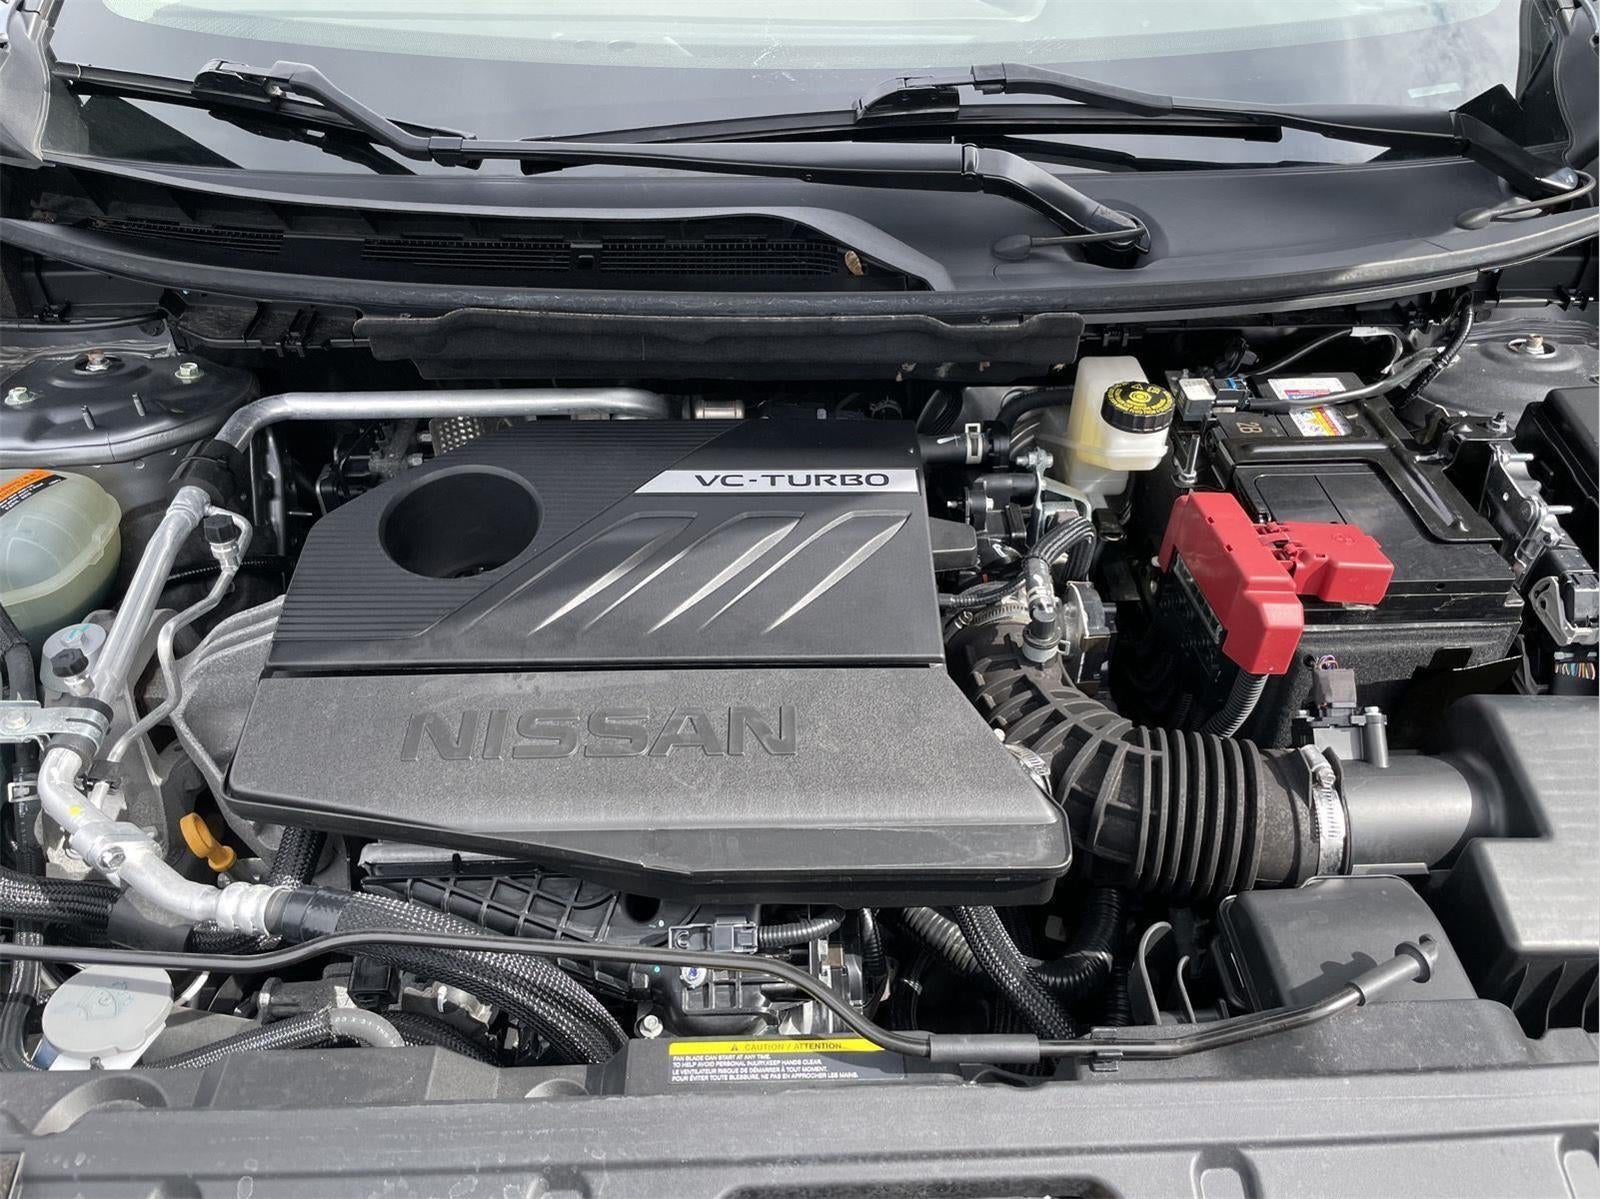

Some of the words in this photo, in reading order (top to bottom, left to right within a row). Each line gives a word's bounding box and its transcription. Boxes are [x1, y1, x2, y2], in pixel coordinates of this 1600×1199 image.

[695, 473, 889, 487] VC-TURBO
[401, 705, 799, 760] NISSAN
[744, 1043, 784, 1051] CAUTION
[794, 1042, 842, 1050] ATTENTION
